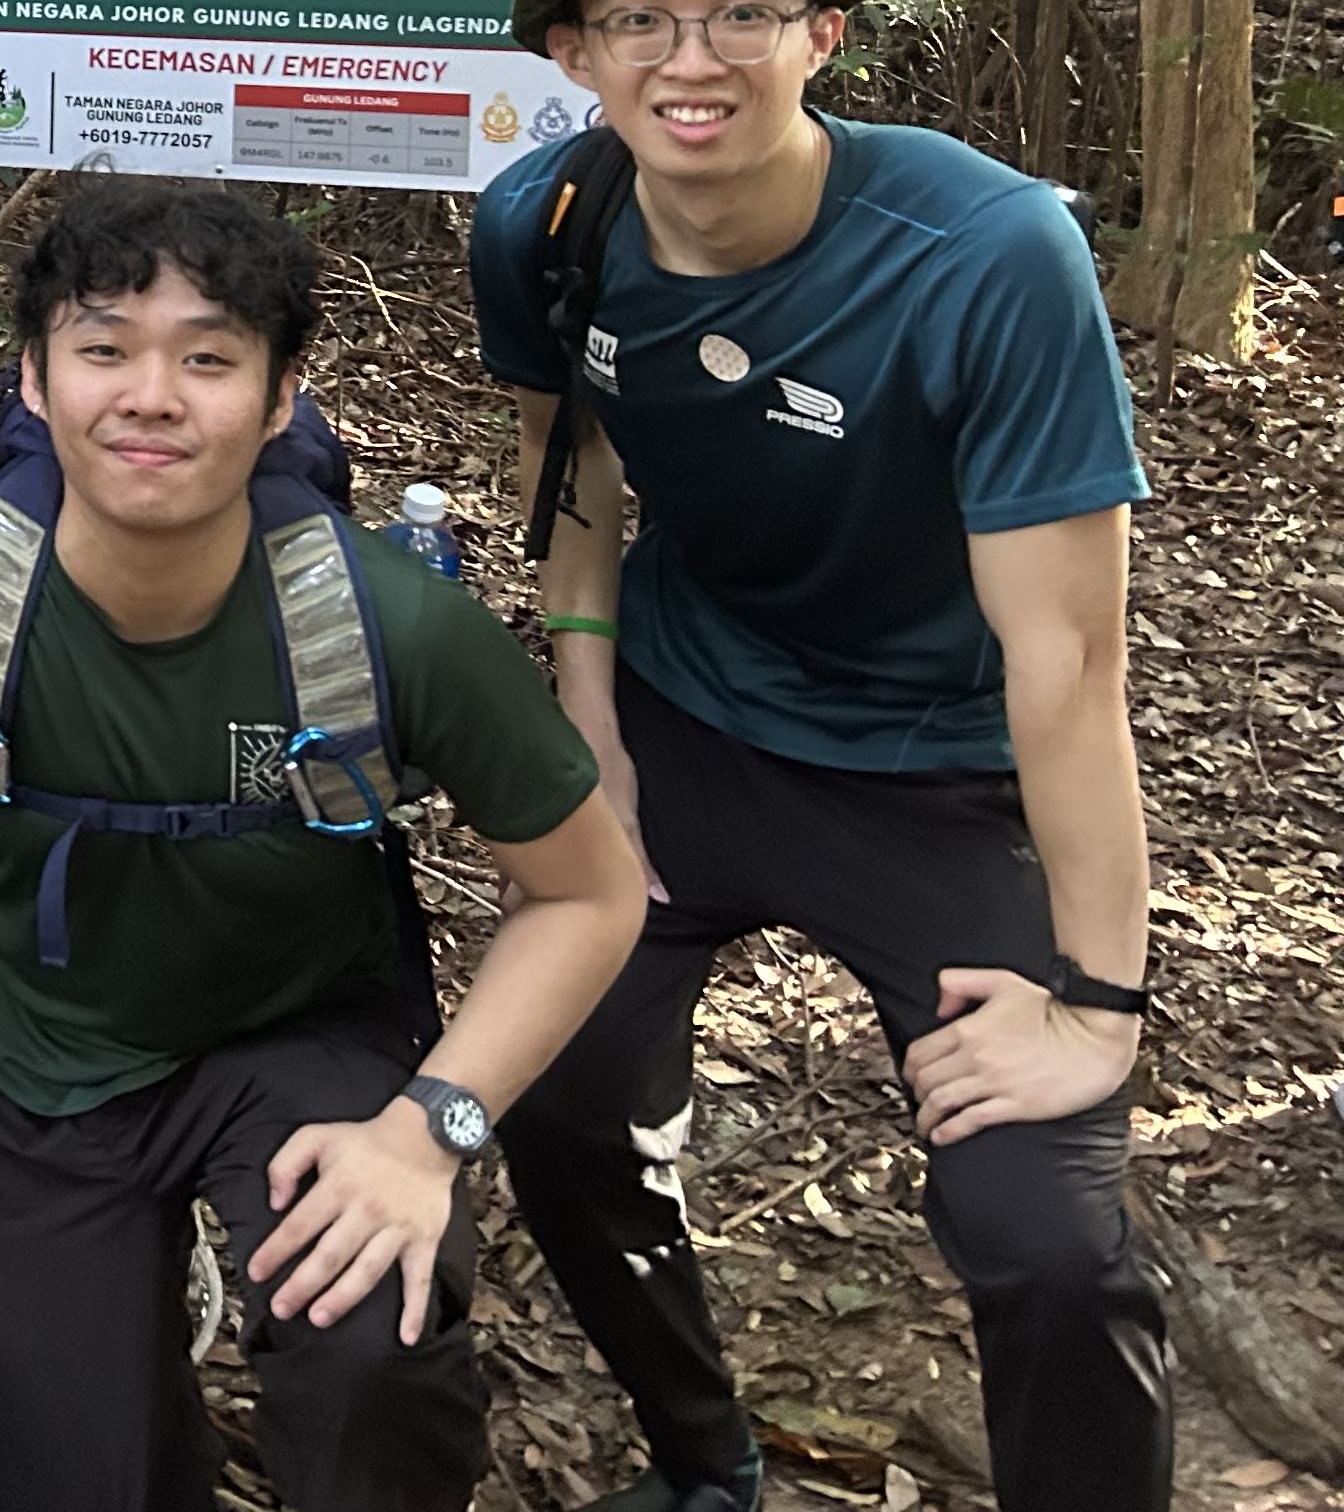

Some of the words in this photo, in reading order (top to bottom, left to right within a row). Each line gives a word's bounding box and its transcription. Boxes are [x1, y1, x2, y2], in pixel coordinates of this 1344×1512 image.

[16, 2, 104, 21] NEGARA
[111, 5, 185, 24] JOHOR
[193, 8, 290, 27] GUNUNG
[298, 12, 389, 31] LEDANG
[89, 48, 255, 75] KECEMASAN
[264, 55, 275, 75] /
[282, 55, 448, 83] EMERGENCY
[65, 96, 112, 108] TAMAN
[116, 98, 173, 112] NEGARA
[176, 101, 224, 115] JOHOR
[303, 94, 352, 105] GUNUNG
[354, 96, 399, 107] LEDANG
[87, 109, 144, 123] GUNUNG
[146, 112, 203, 126] LEDANG
[79, 128, 214, 149] +6019-7772057
[766, 409, 844, 439] PRESSIO
